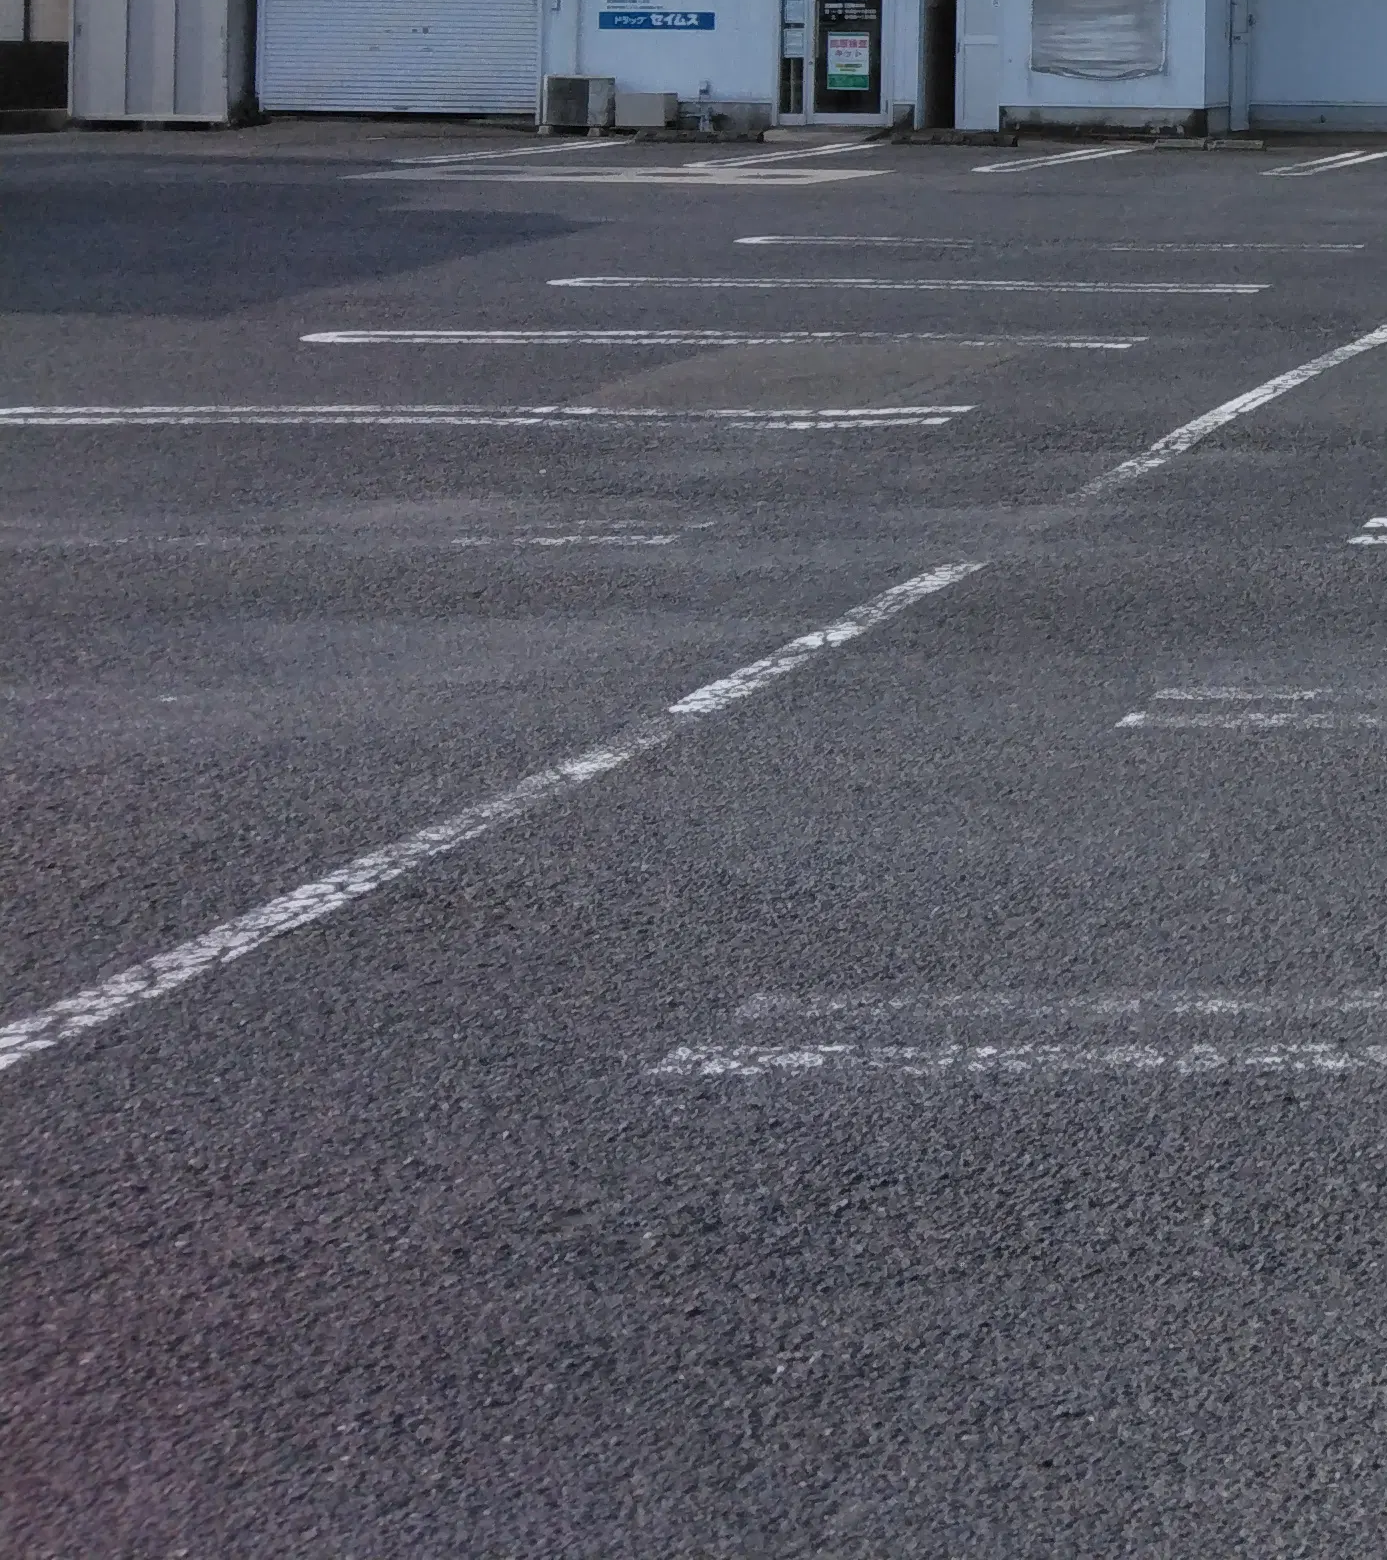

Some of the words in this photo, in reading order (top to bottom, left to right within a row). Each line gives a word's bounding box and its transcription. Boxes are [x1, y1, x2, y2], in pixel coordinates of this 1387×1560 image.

[614, 15, 648, 25] ドラッグ
[650, 13, 699, 26] セイムス
